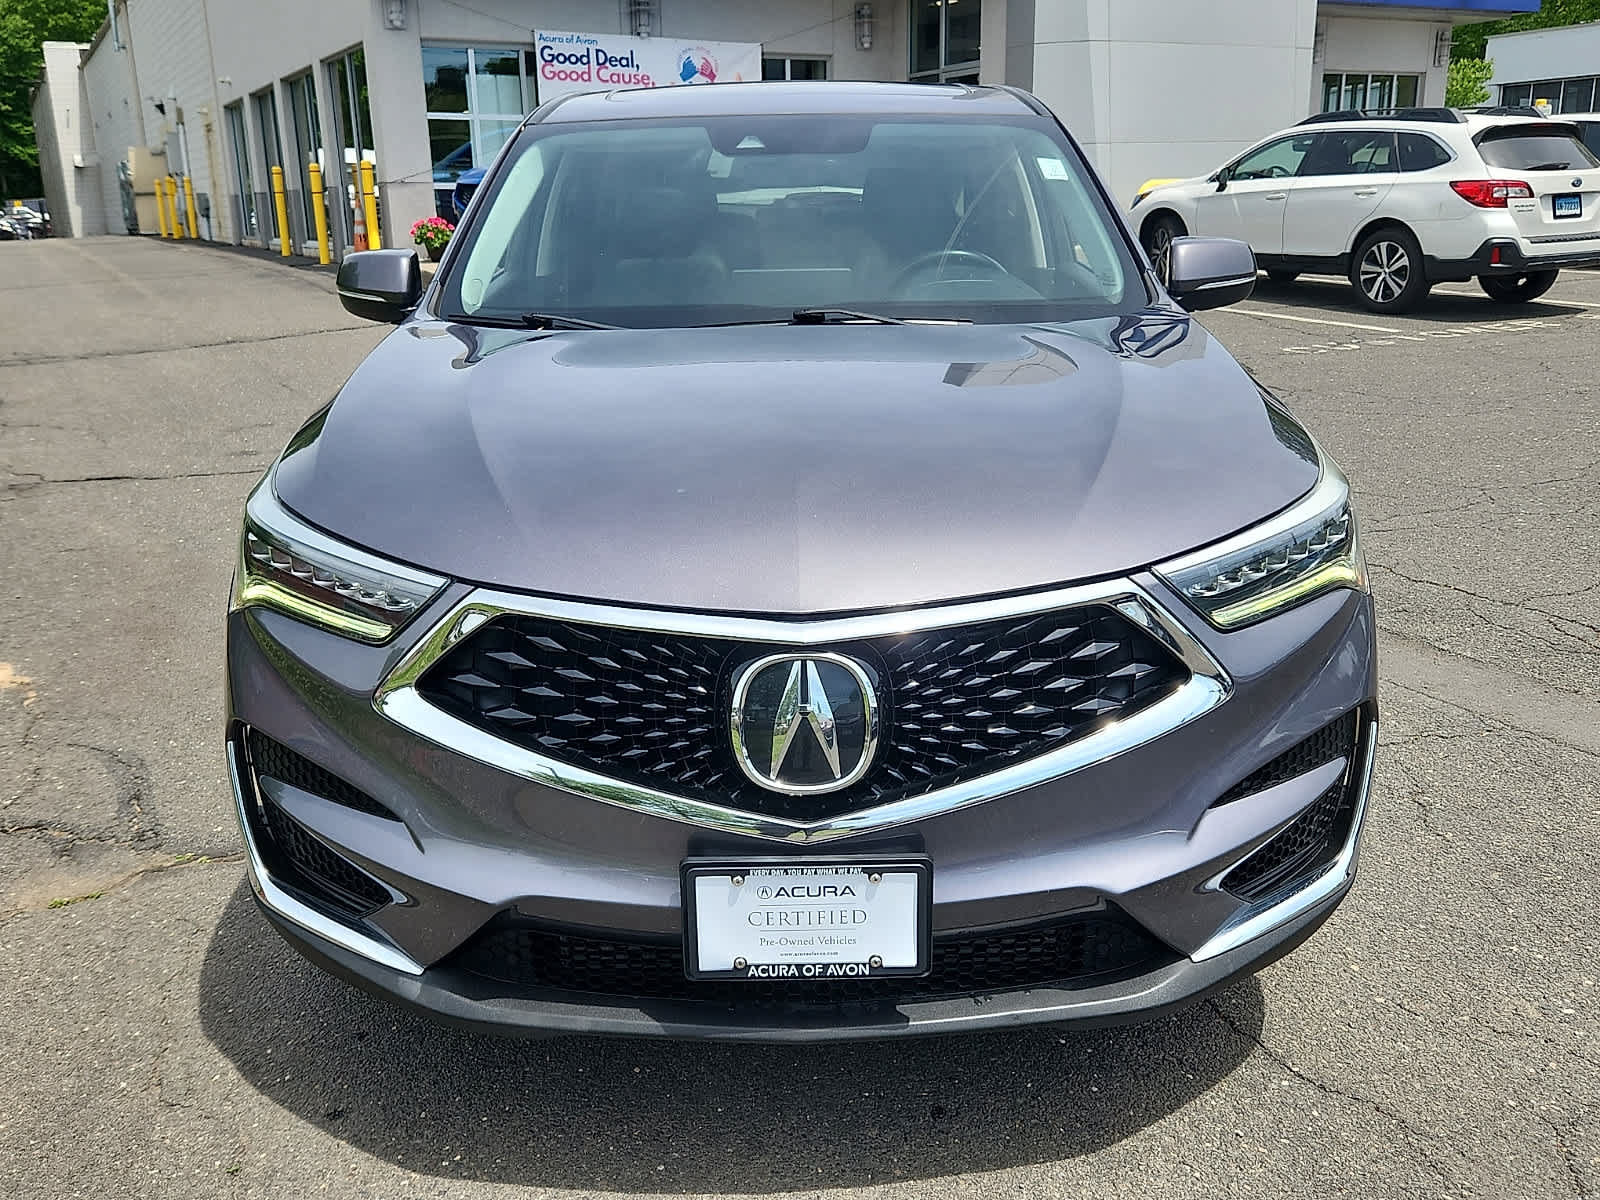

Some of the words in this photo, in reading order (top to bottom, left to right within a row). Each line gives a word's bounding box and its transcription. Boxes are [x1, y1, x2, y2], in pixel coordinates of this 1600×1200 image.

[538, 33, 564, 45] Acura
[565, 35, 574, 45] of
[575, 35, 598, 46] Avon
[540, 45, 590, 65] Good
[595, 49, 640, 71] Deal,
[541, 62, 591, 82] Good
[787, 868, 802, 876] YOU
[803, 868, 815, 876] PAY
[816, 868, 836, 876] WHAT
[774, 885, 856, 898] ACURA
[748, 909, 867, 927] CERTIFIED
[760, 937, 815, 947] Pre-Owned
[817, 936, 857, 946] Vehicles
[747, 965, 799, 977] ACURA
[803, 965, 823, 977] OF
[827, 964, 870, 977] AVON
